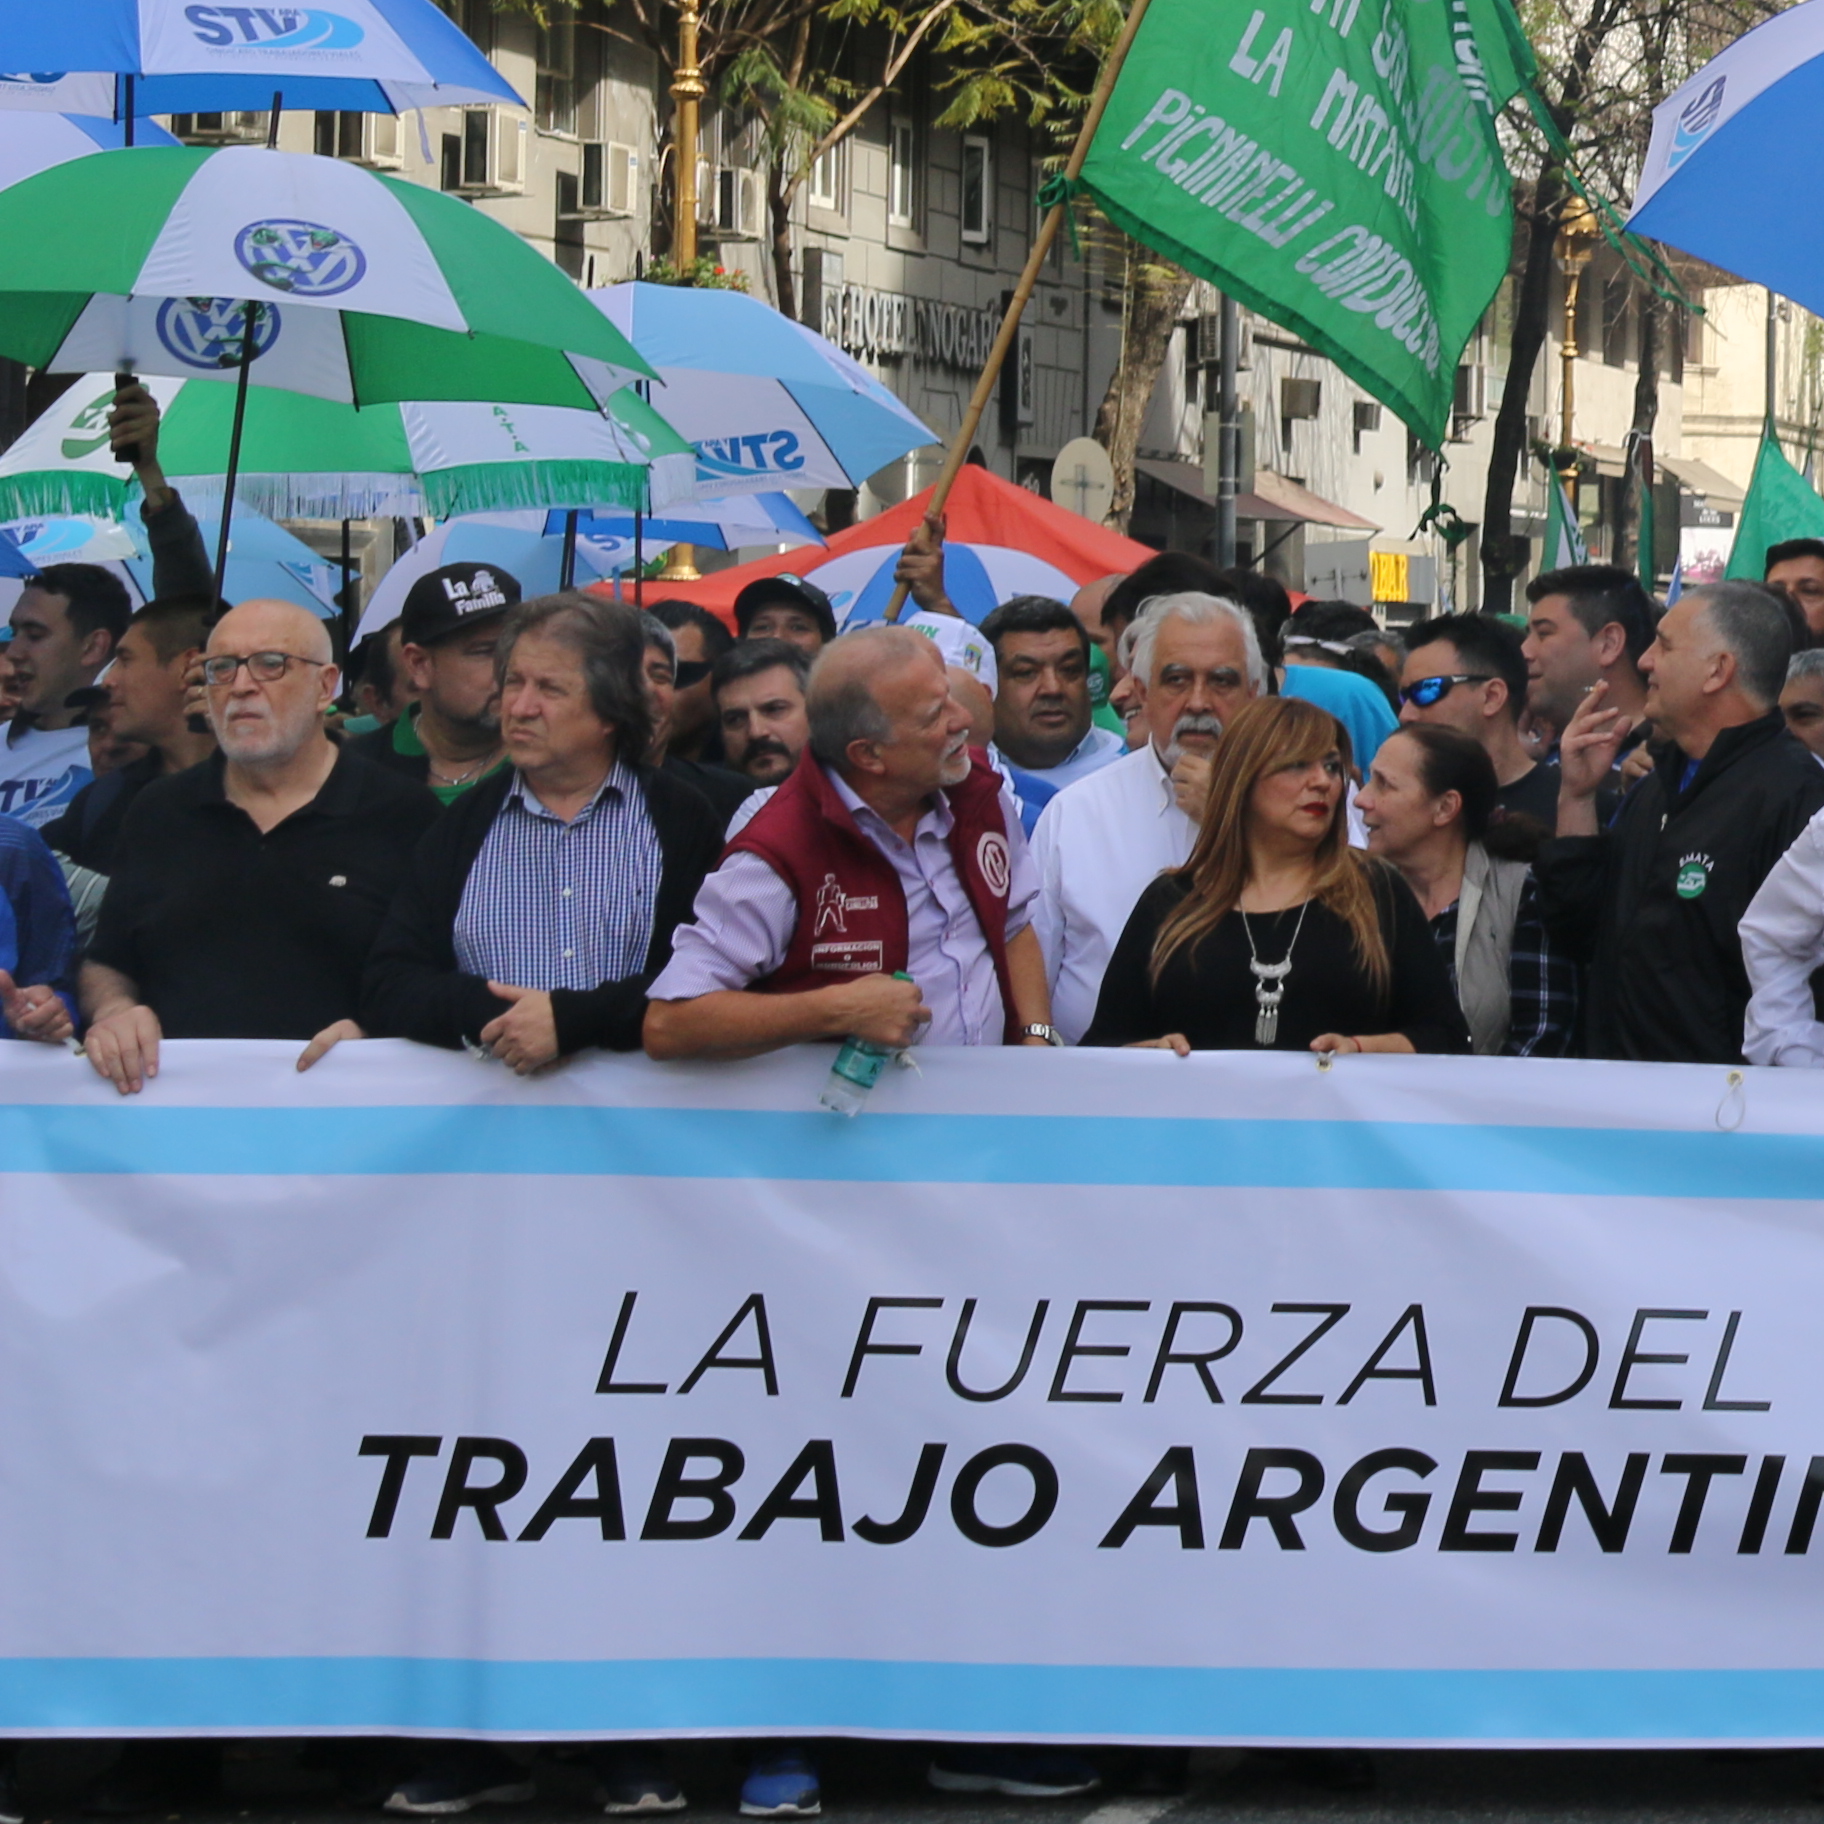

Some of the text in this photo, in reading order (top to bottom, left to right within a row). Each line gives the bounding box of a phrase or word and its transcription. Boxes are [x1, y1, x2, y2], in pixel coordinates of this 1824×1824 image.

[185, 4, 298, 47] STV
[1228, 9, 1294, 99] LA
[848, 283, 917, 354] HOTEL
[442, 578, 470, 600] La
[596, 1292, 1771, 1411] LA FUERZA DEL
[357, 1435, 1060, 1549] TRABAJO
